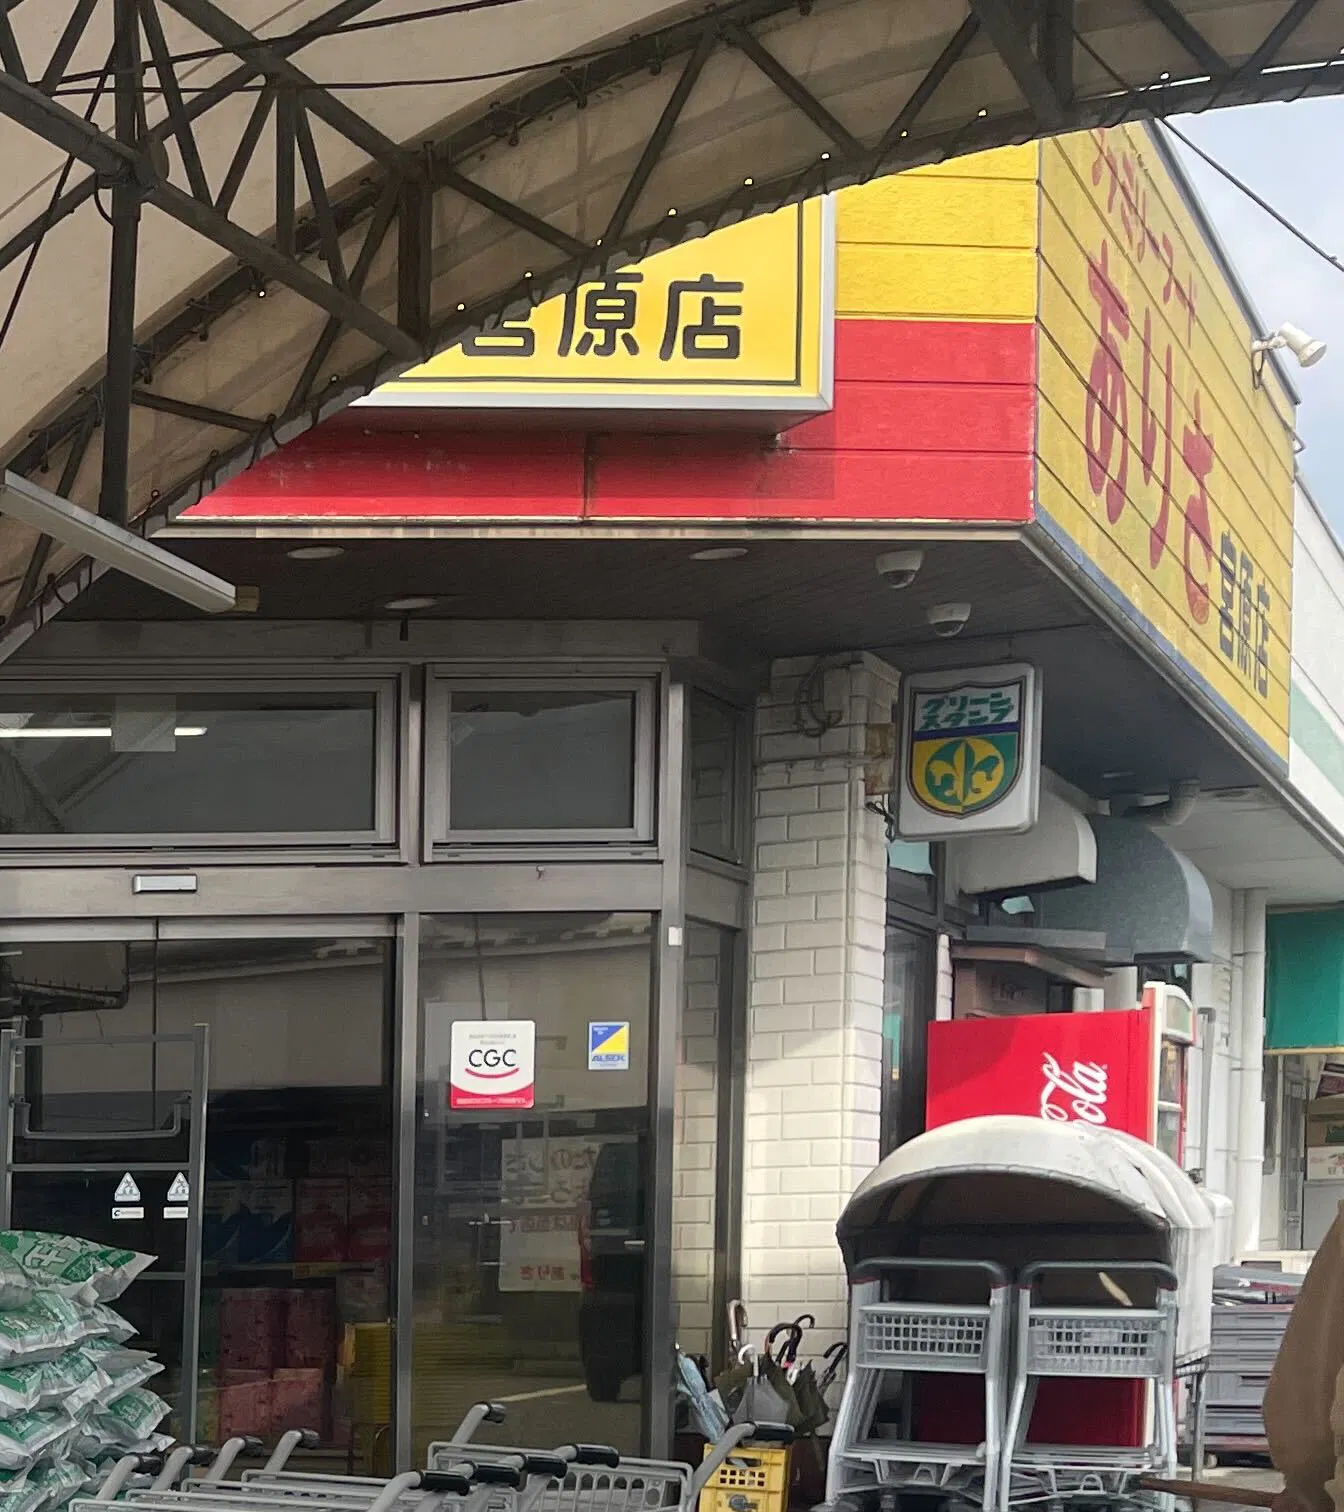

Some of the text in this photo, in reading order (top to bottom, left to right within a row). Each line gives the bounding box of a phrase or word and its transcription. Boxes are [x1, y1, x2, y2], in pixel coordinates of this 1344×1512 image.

[1085, 238, 1214, 625] ありさ
[1219, 529, 1270, 699] 宮原店
[468, 1048, 517, 1068] CGC
